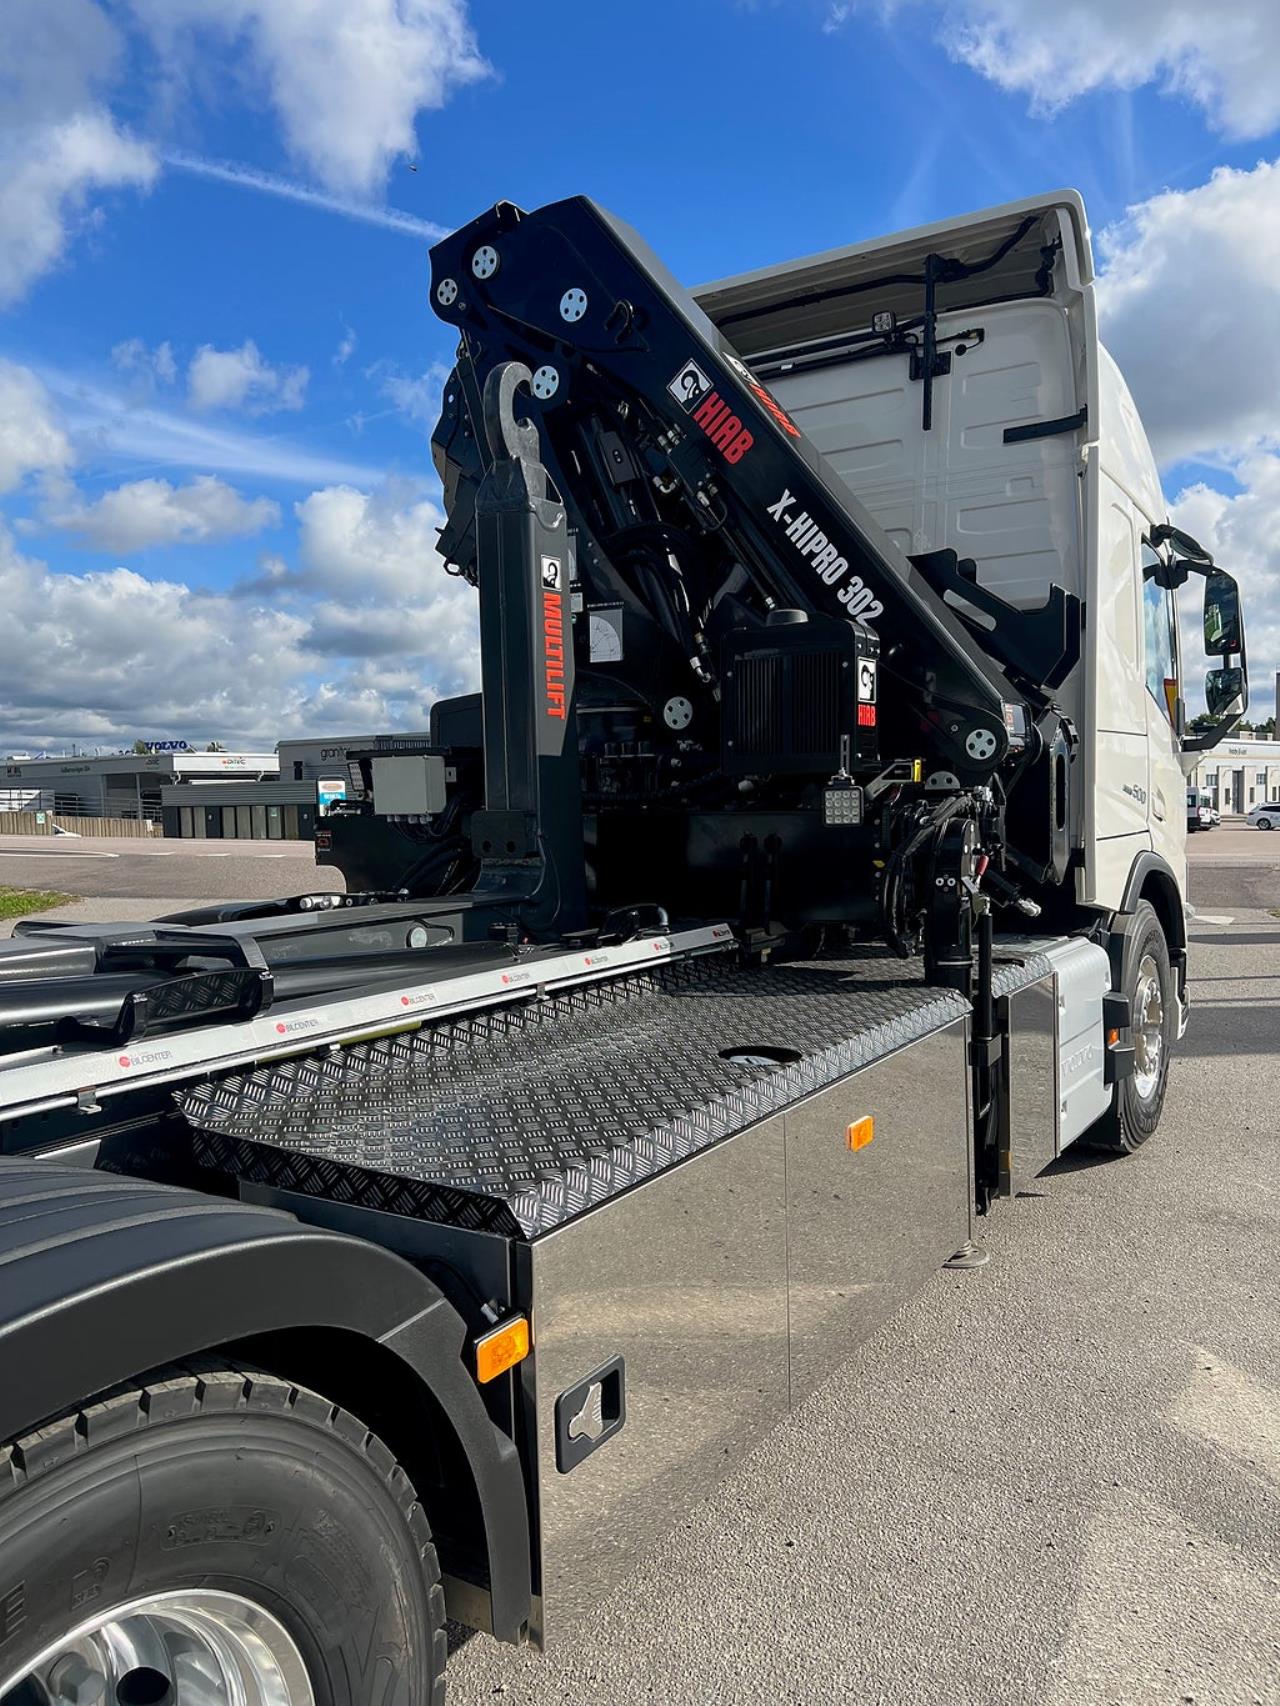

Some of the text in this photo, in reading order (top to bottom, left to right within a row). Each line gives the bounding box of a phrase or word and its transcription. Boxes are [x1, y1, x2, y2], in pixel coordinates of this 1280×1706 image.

[693, 391, 755, 465] HIAB
[766, 488, 884, 627] X-HIPRO 302
[544, 592, 566, 720] MULTILIFT
[858, 704, 876, 727] HIAB
[145, 741, 187, 751] VOLVO
[285, 1018, 320, 1033] BILCENTER
[131, 1050, 173, 1067] BILCENTER
